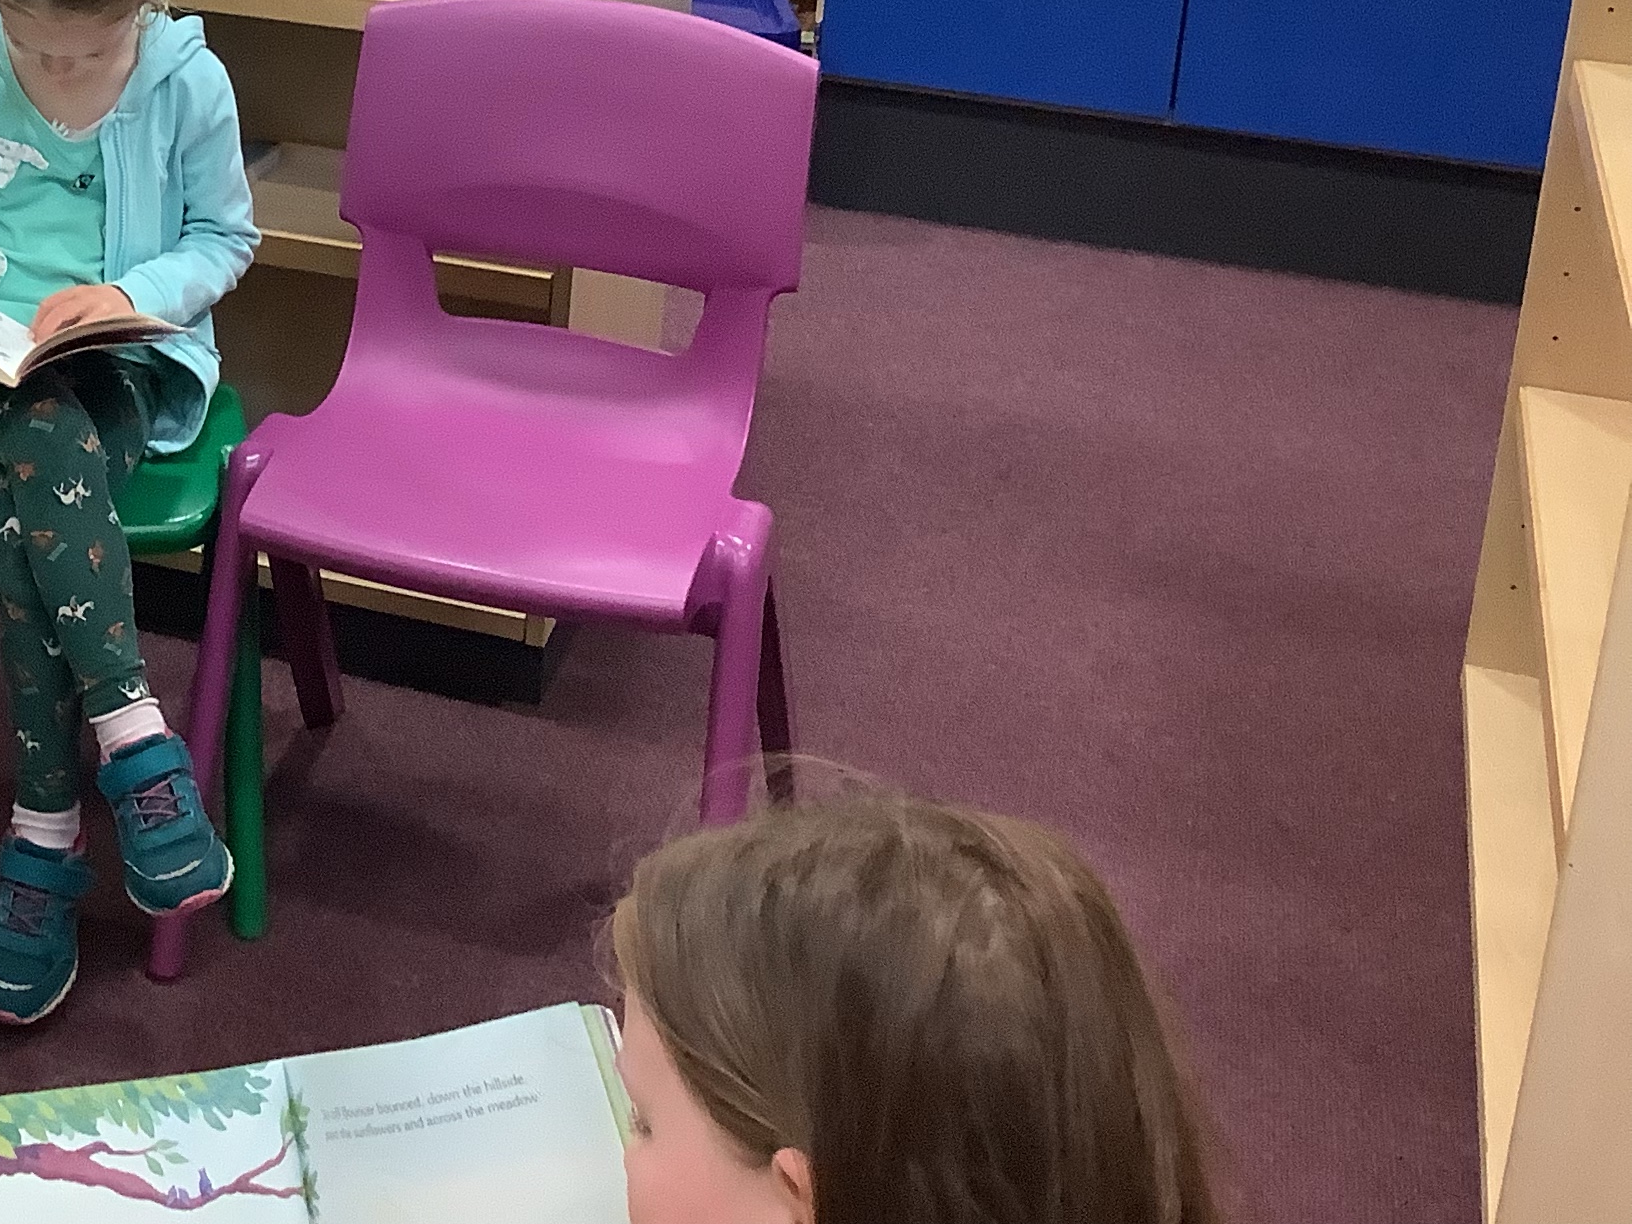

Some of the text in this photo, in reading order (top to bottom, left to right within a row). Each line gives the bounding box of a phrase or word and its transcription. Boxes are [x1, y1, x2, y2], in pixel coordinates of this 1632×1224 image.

[426, 1088, 460, 1106] down
[462, 1083, 482, 1098] the
[404, 1117, 424, 1131] and
[426, 1111, 463, 1127] across
[464, 1105, 484, 1119] the
